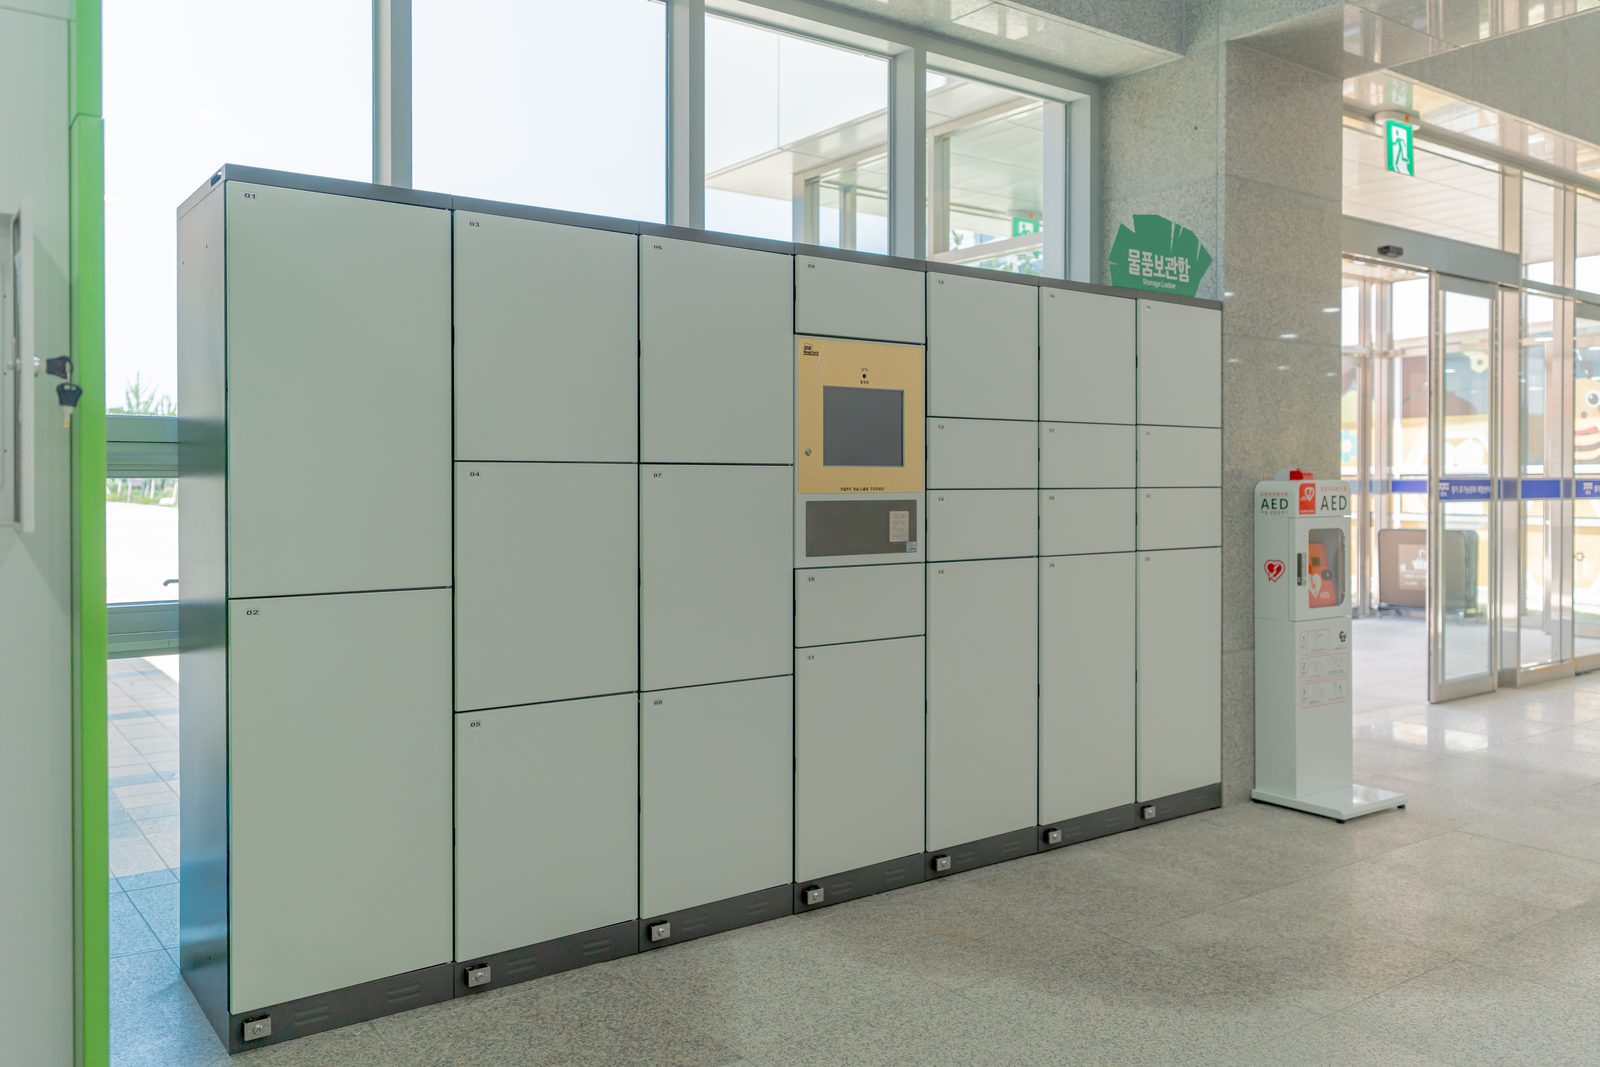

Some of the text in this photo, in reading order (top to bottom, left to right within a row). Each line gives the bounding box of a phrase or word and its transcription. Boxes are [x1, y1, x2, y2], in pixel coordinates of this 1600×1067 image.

[244, 192, 256, 200] 01
[1127, 248, 1191, 283] 물품보관함
[1142, 278, 1176, 289] Storage Locker
[1261, 498, 1289, 510] AED
[1320, 496, 1347, 511] AED
[246, 608, 259, 616] 02
